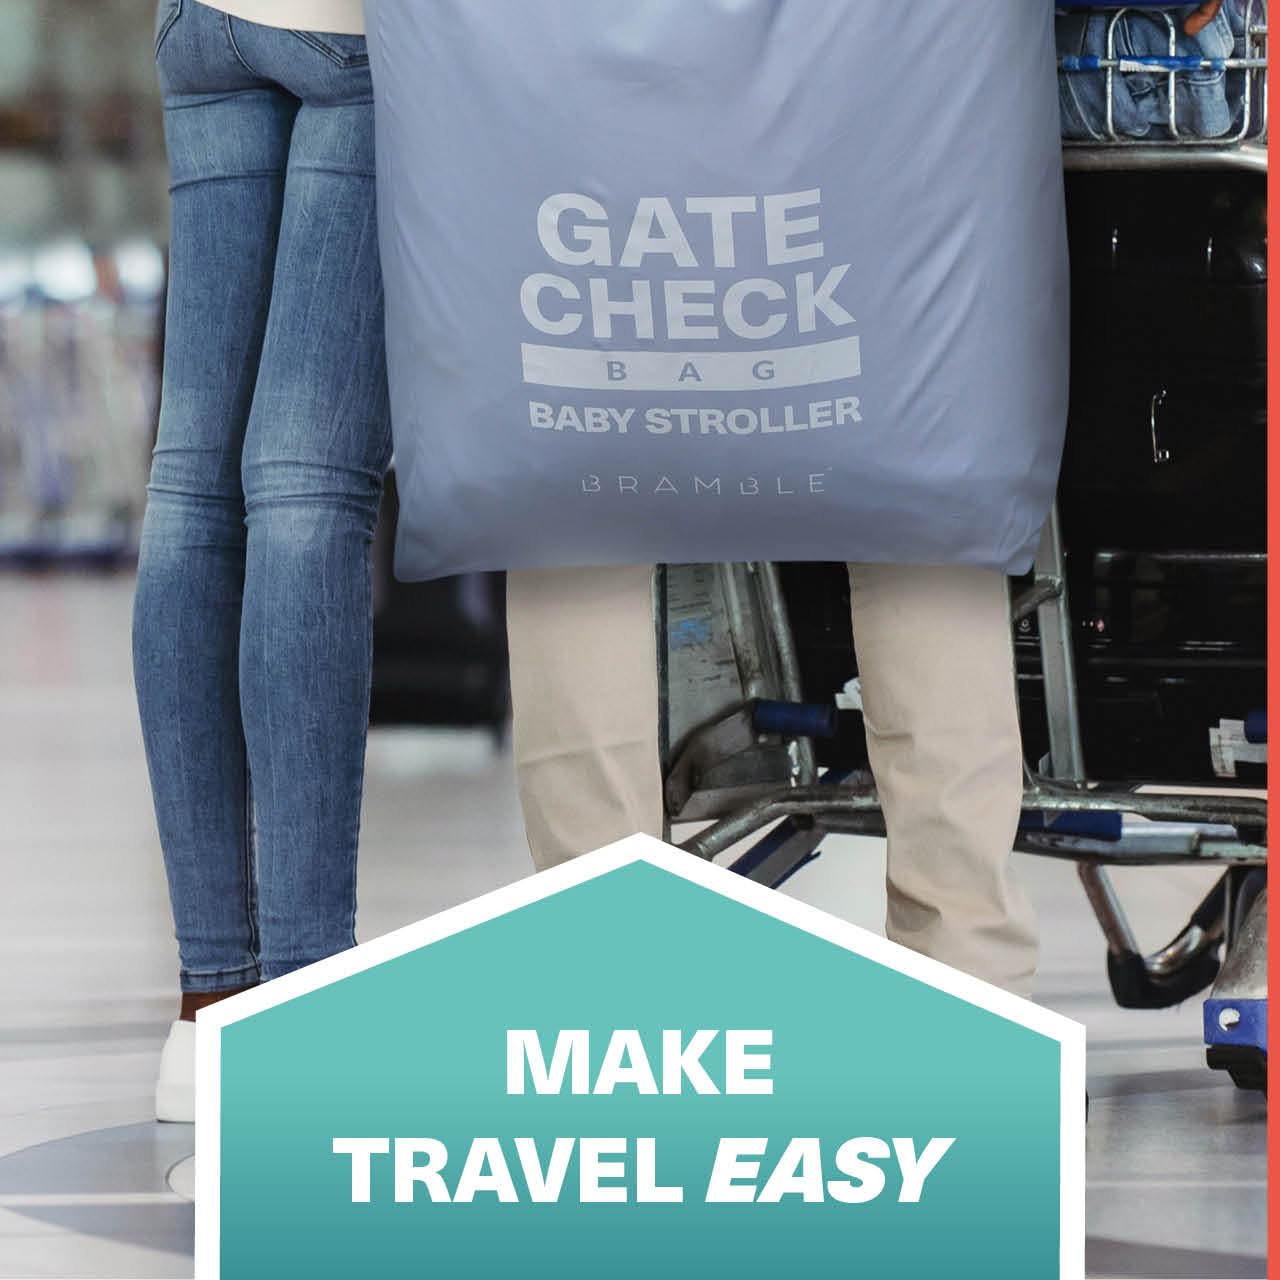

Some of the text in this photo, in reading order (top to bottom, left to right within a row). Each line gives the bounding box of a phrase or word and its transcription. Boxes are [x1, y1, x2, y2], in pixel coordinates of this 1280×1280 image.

[537, 188, 824, 268] GATE
[519, 263, 857, 339] CHECK
[606, 360, 776, 382] BAG
[528, 395, 863, 434] BABY STROLLER
[582, 472, 826, 496] BRAMBLE
